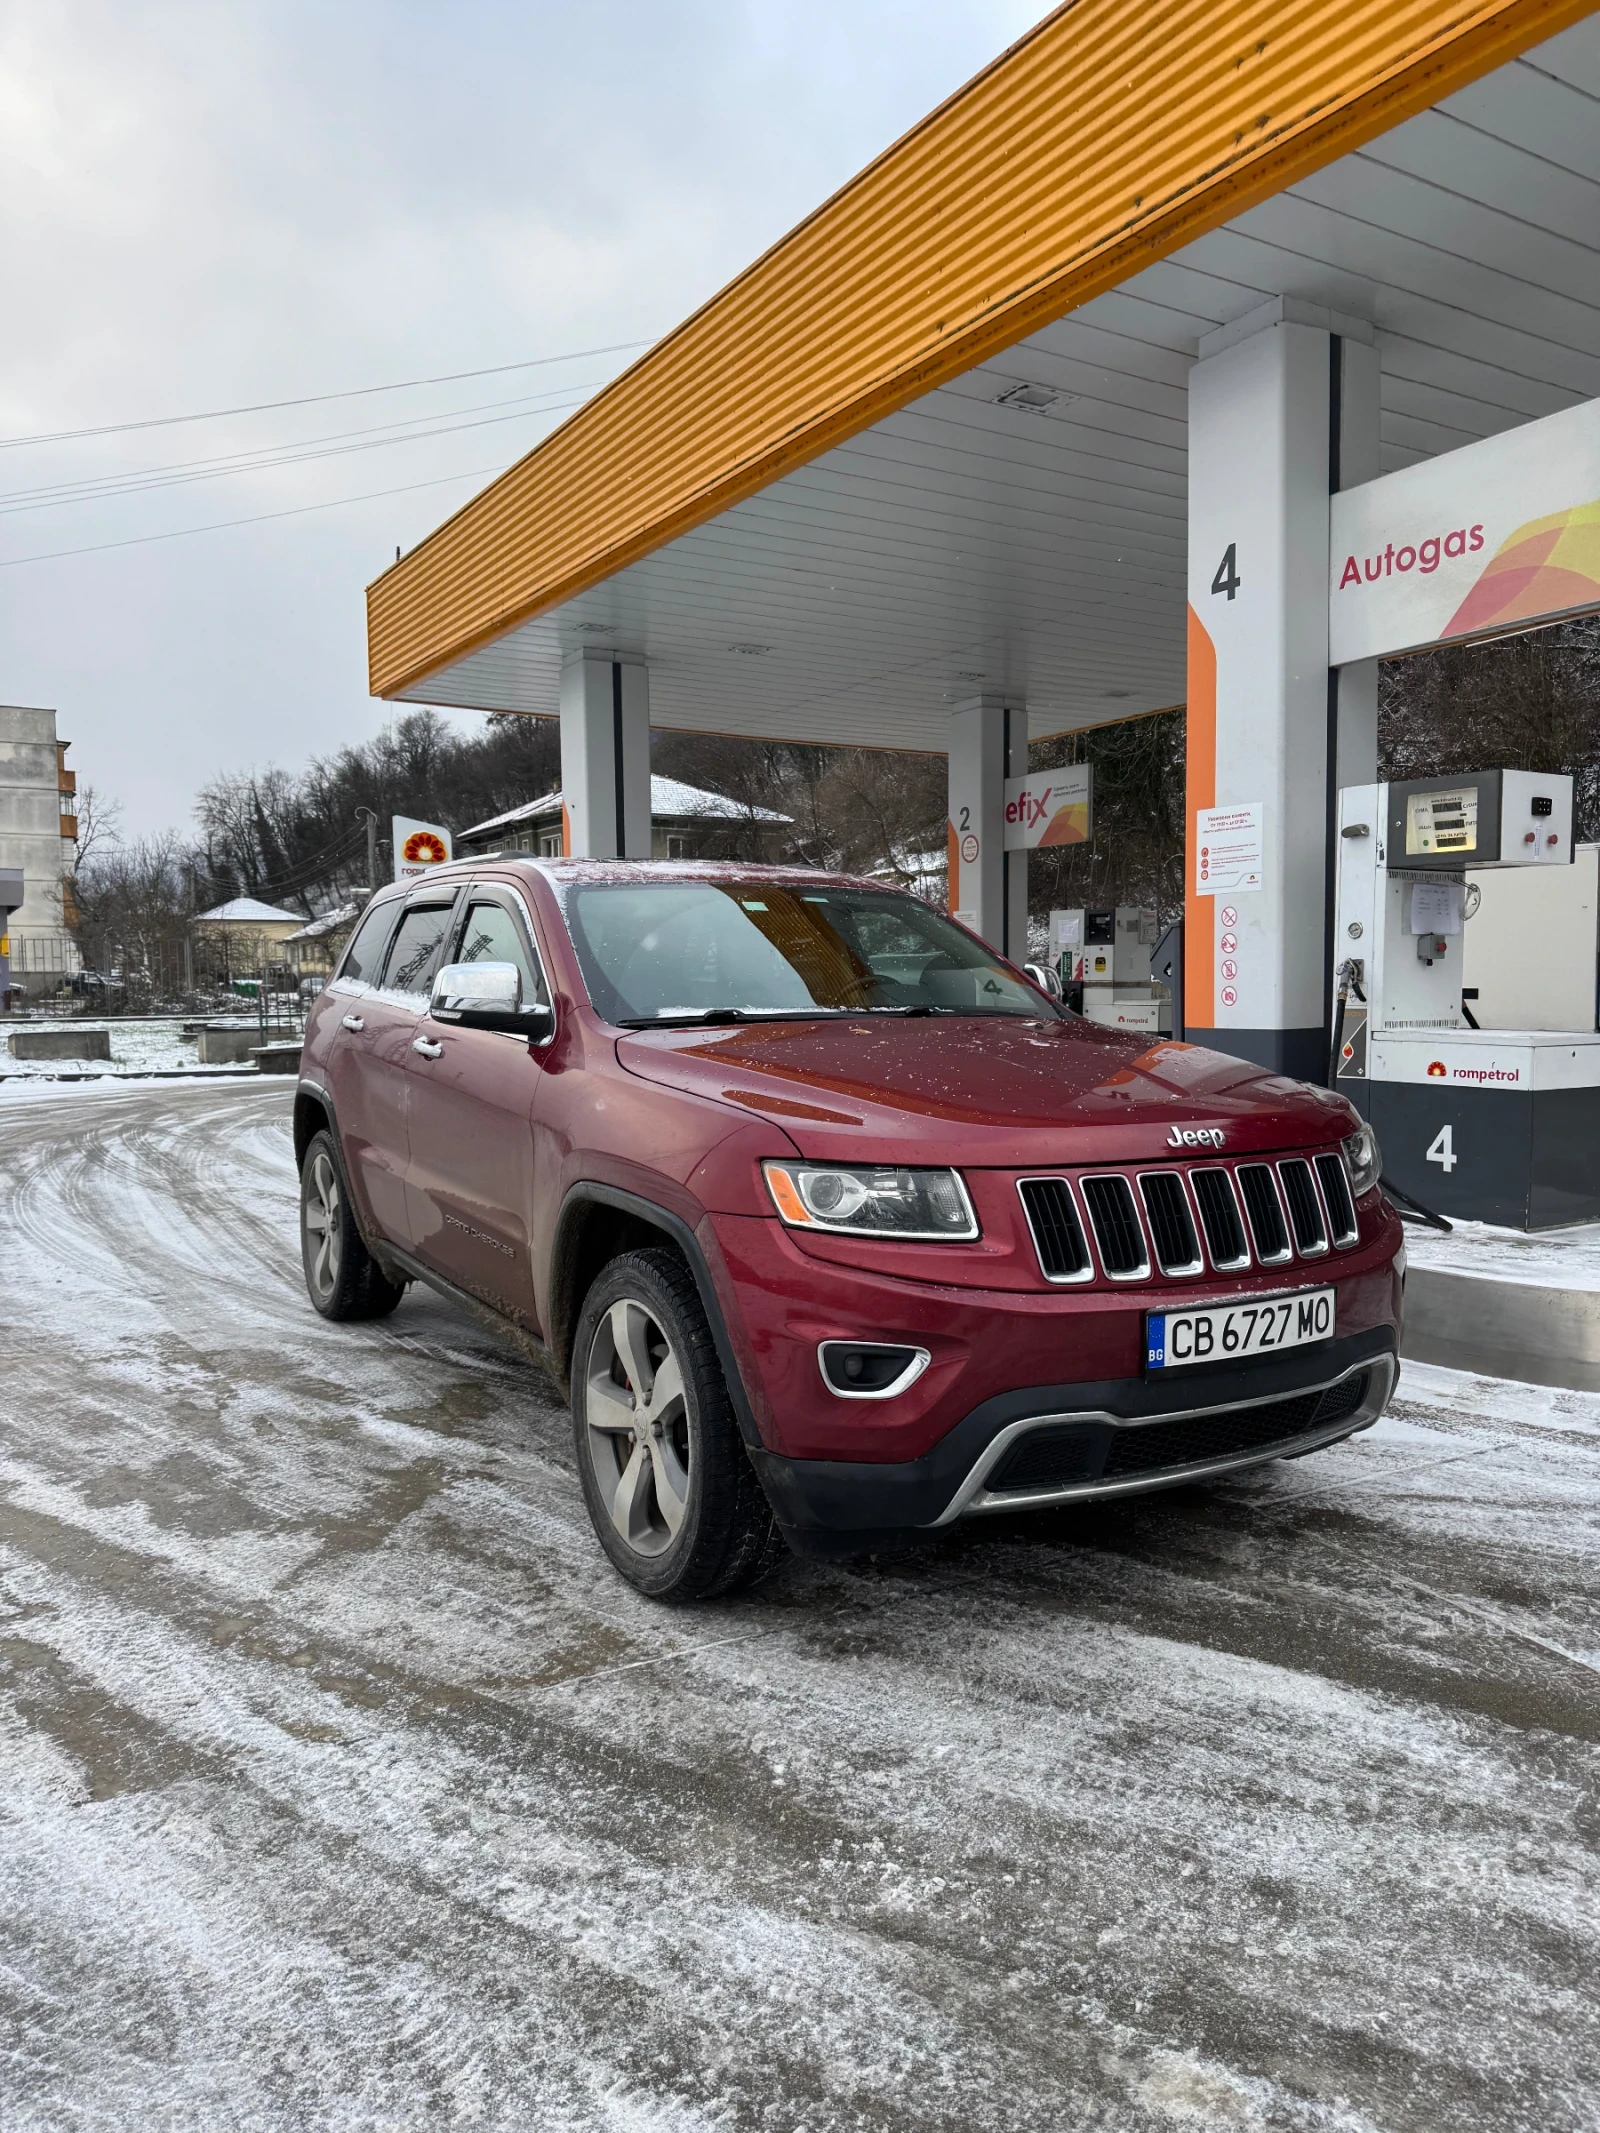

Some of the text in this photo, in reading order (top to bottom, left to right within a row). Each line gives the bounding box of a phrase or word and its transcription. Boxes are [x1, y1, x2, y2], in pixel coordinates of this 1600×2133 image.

[1211, 542, 1240, 601] 4
[1339, 524, 1484, 591] Autogas
[960, 806, 970, 831] 2
[1005, 787, 1052, 829] efix
[1453, 1068, 1519, 1083] rompetrol
[1166, 1125, 1226, 1150] Jeep
[1426, 1124, 1457, 1173] 4
[1172, 1296, 1330, 1359] CB 6727 MO
[1148, 1348, 1164, 1362] BG
